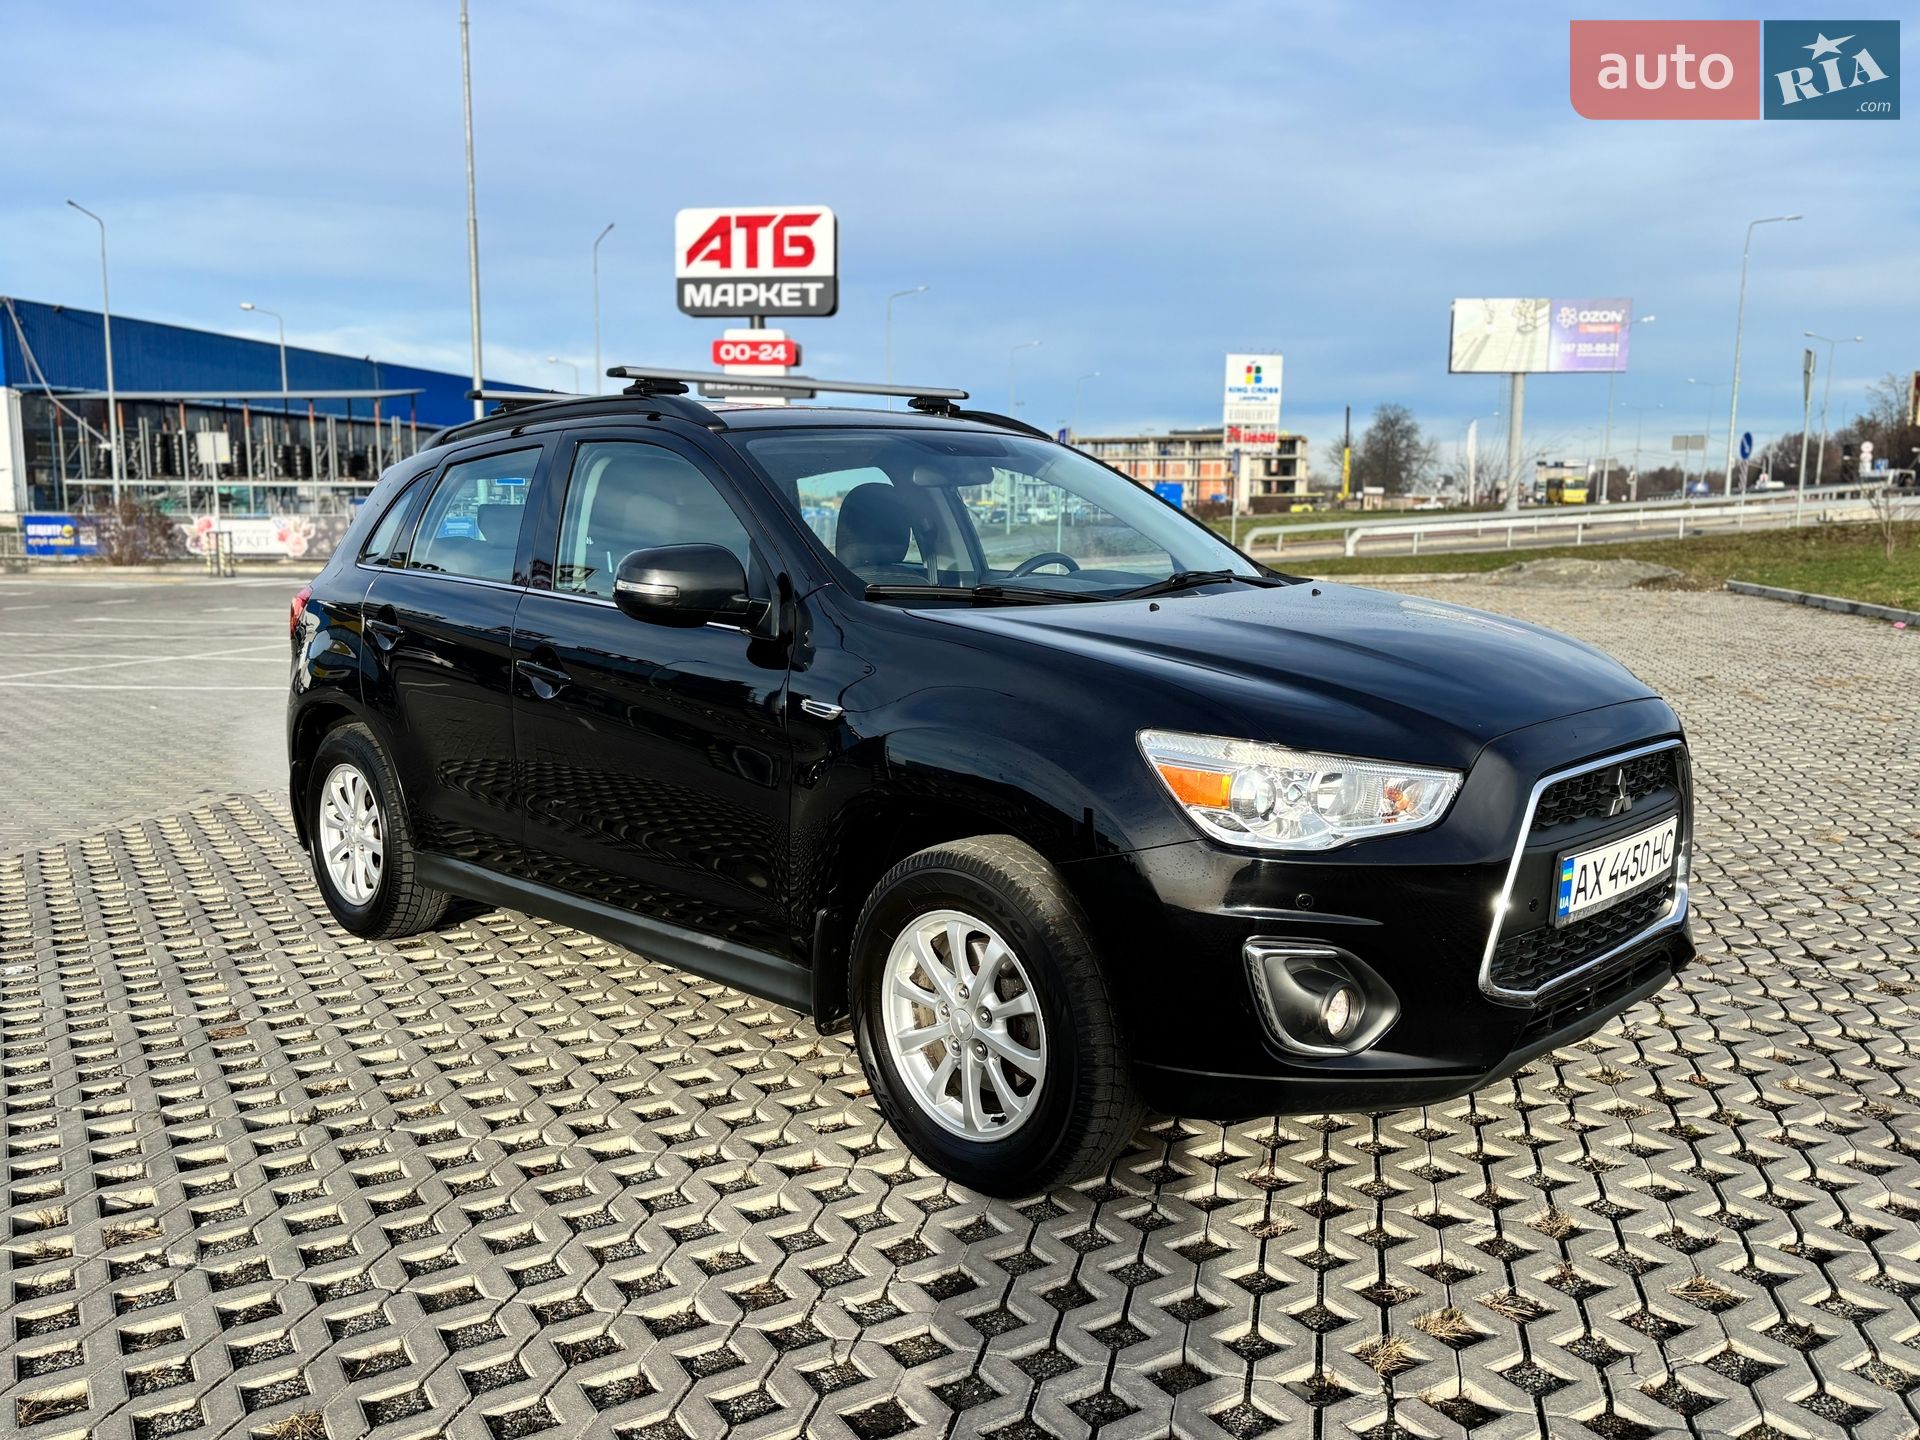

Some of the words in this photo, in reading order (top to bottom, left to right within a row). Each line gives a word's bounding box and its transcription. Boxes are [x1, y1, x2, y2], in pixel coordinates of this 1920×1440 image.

[686, 213, 822, 269] АТБ
[683, 282, 824, 308] МАРКЕТ
[1578, 309, 1622, 323] OZON
[719, 344, 787, 361] 00-24
[1228, 386, 1248, 394] KING
[1251, 386, 1278, 395] CROSS
[1573, 857, 1606, 905] AX
[1609, 841, 1650, 889] 4450
[1651, 829, 1674, 873] HC
[1559, 897, 1569, 909] UA
